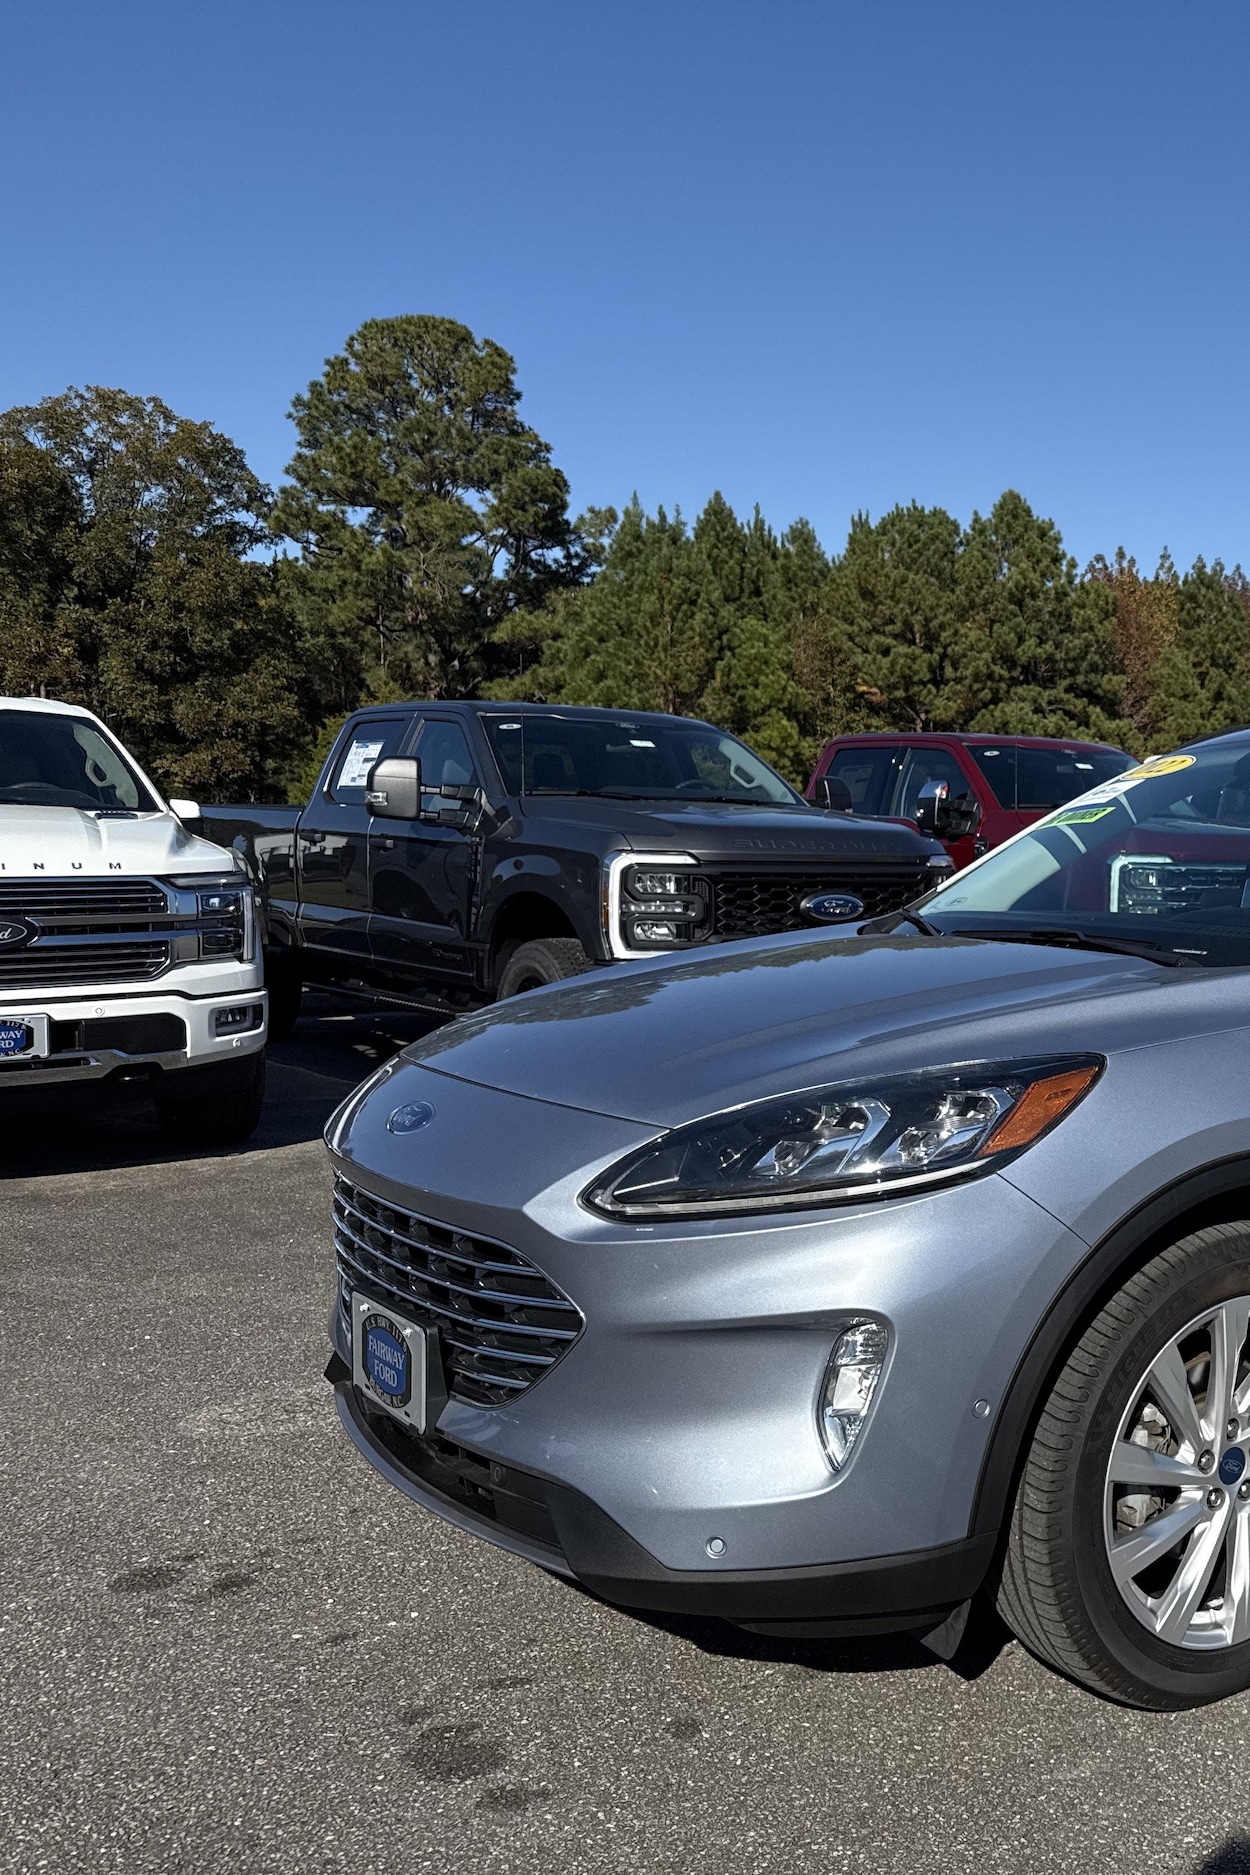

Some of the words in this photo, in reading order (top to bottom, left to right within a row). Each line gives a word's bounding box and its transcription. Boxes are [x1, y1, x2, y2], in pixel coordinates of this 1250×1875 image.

[821, 899, 851, 914] Ford
[393, 1105, 422, 1126] Ford
[368, 1334, 405, 1370] FAIRWAY
[1102, 1293, 1192, 1407] MICHELIN
[374, 1358, 397, 1388] FORD
